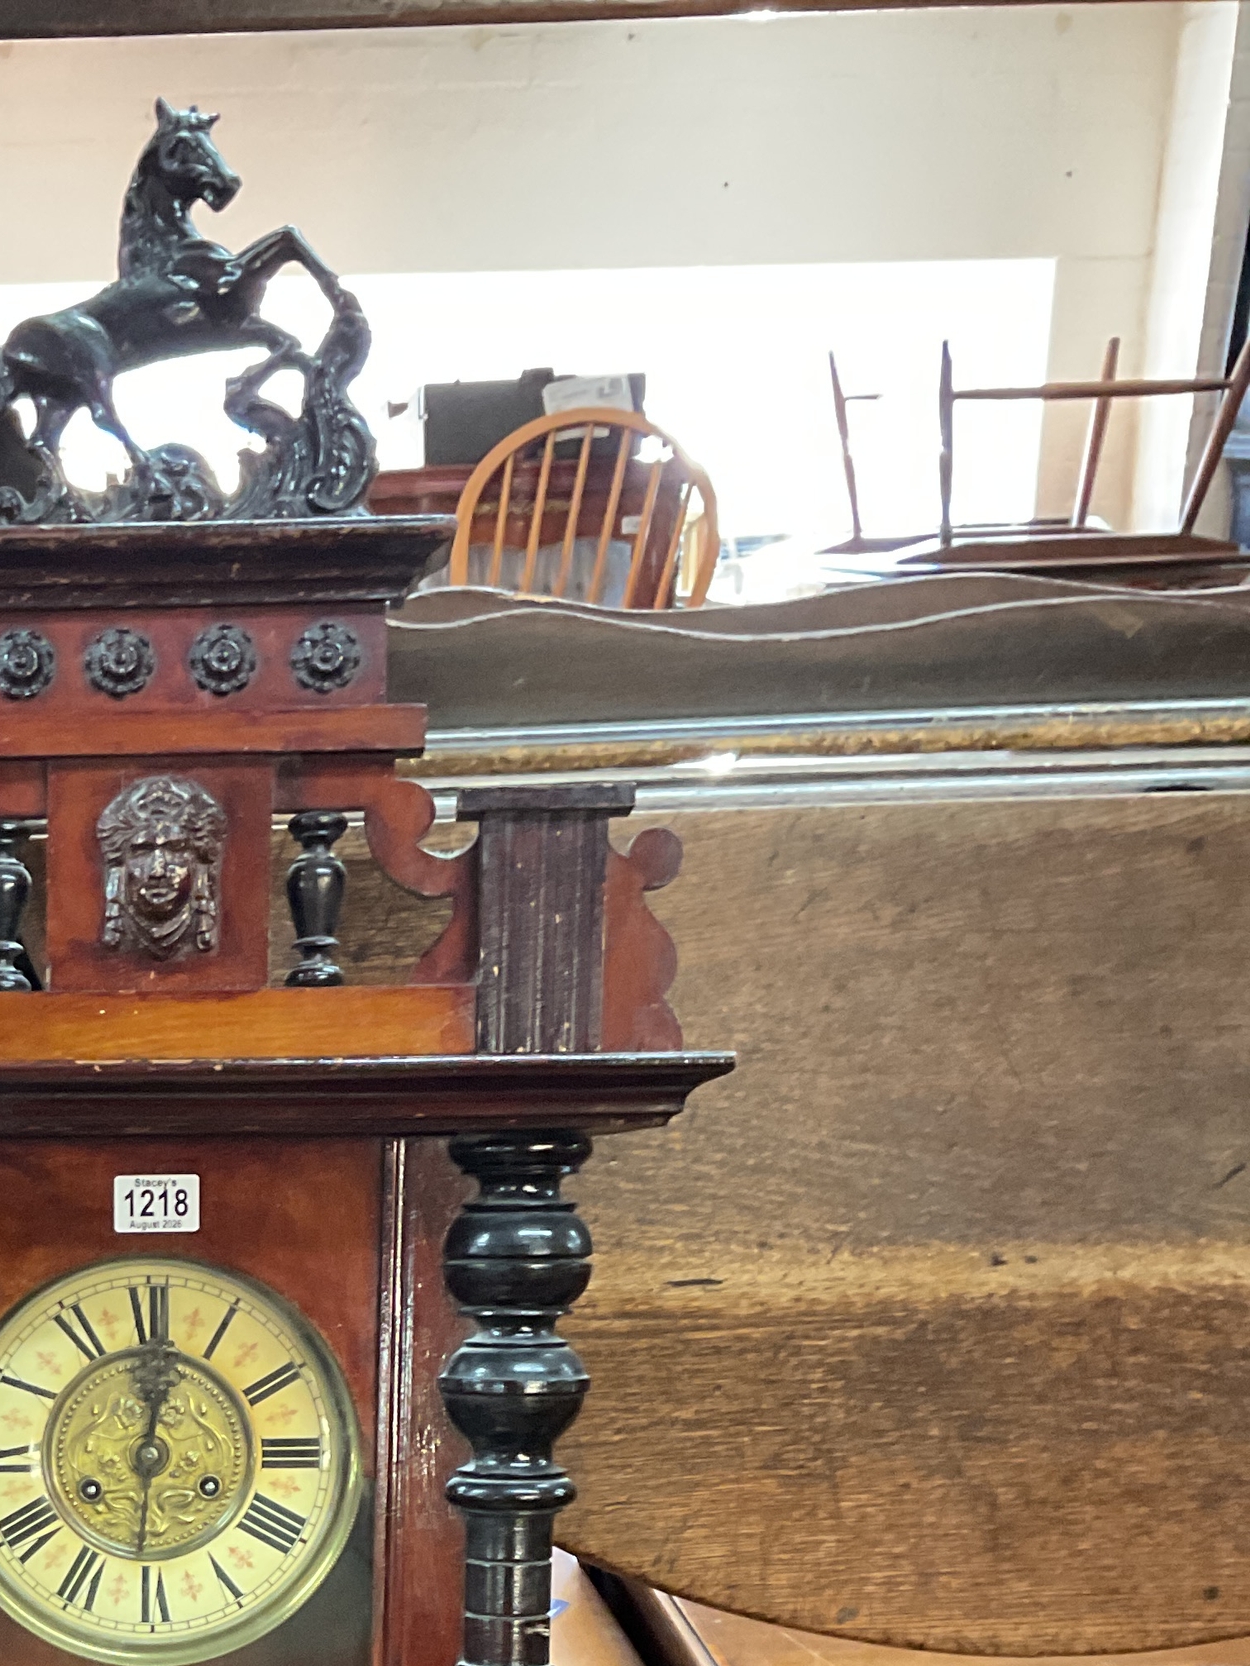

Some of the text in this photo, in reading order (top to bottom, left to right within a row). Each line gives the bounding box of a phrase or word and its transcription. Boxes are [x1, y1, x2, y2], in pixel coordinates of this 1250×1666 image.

[125, 1189, 188, 1216] 1218
[135, 1178, 177, 1190] Stacey's
[130, 1220, 160, 1230] August
[53, 1303, 107, 1361] XI
[242, 1360, 302, 1407] II
[261, 1437, 321, 1469] III
[236, 1493, 308, 1556] IIII
[141, 1565, 171, 1623] VI
